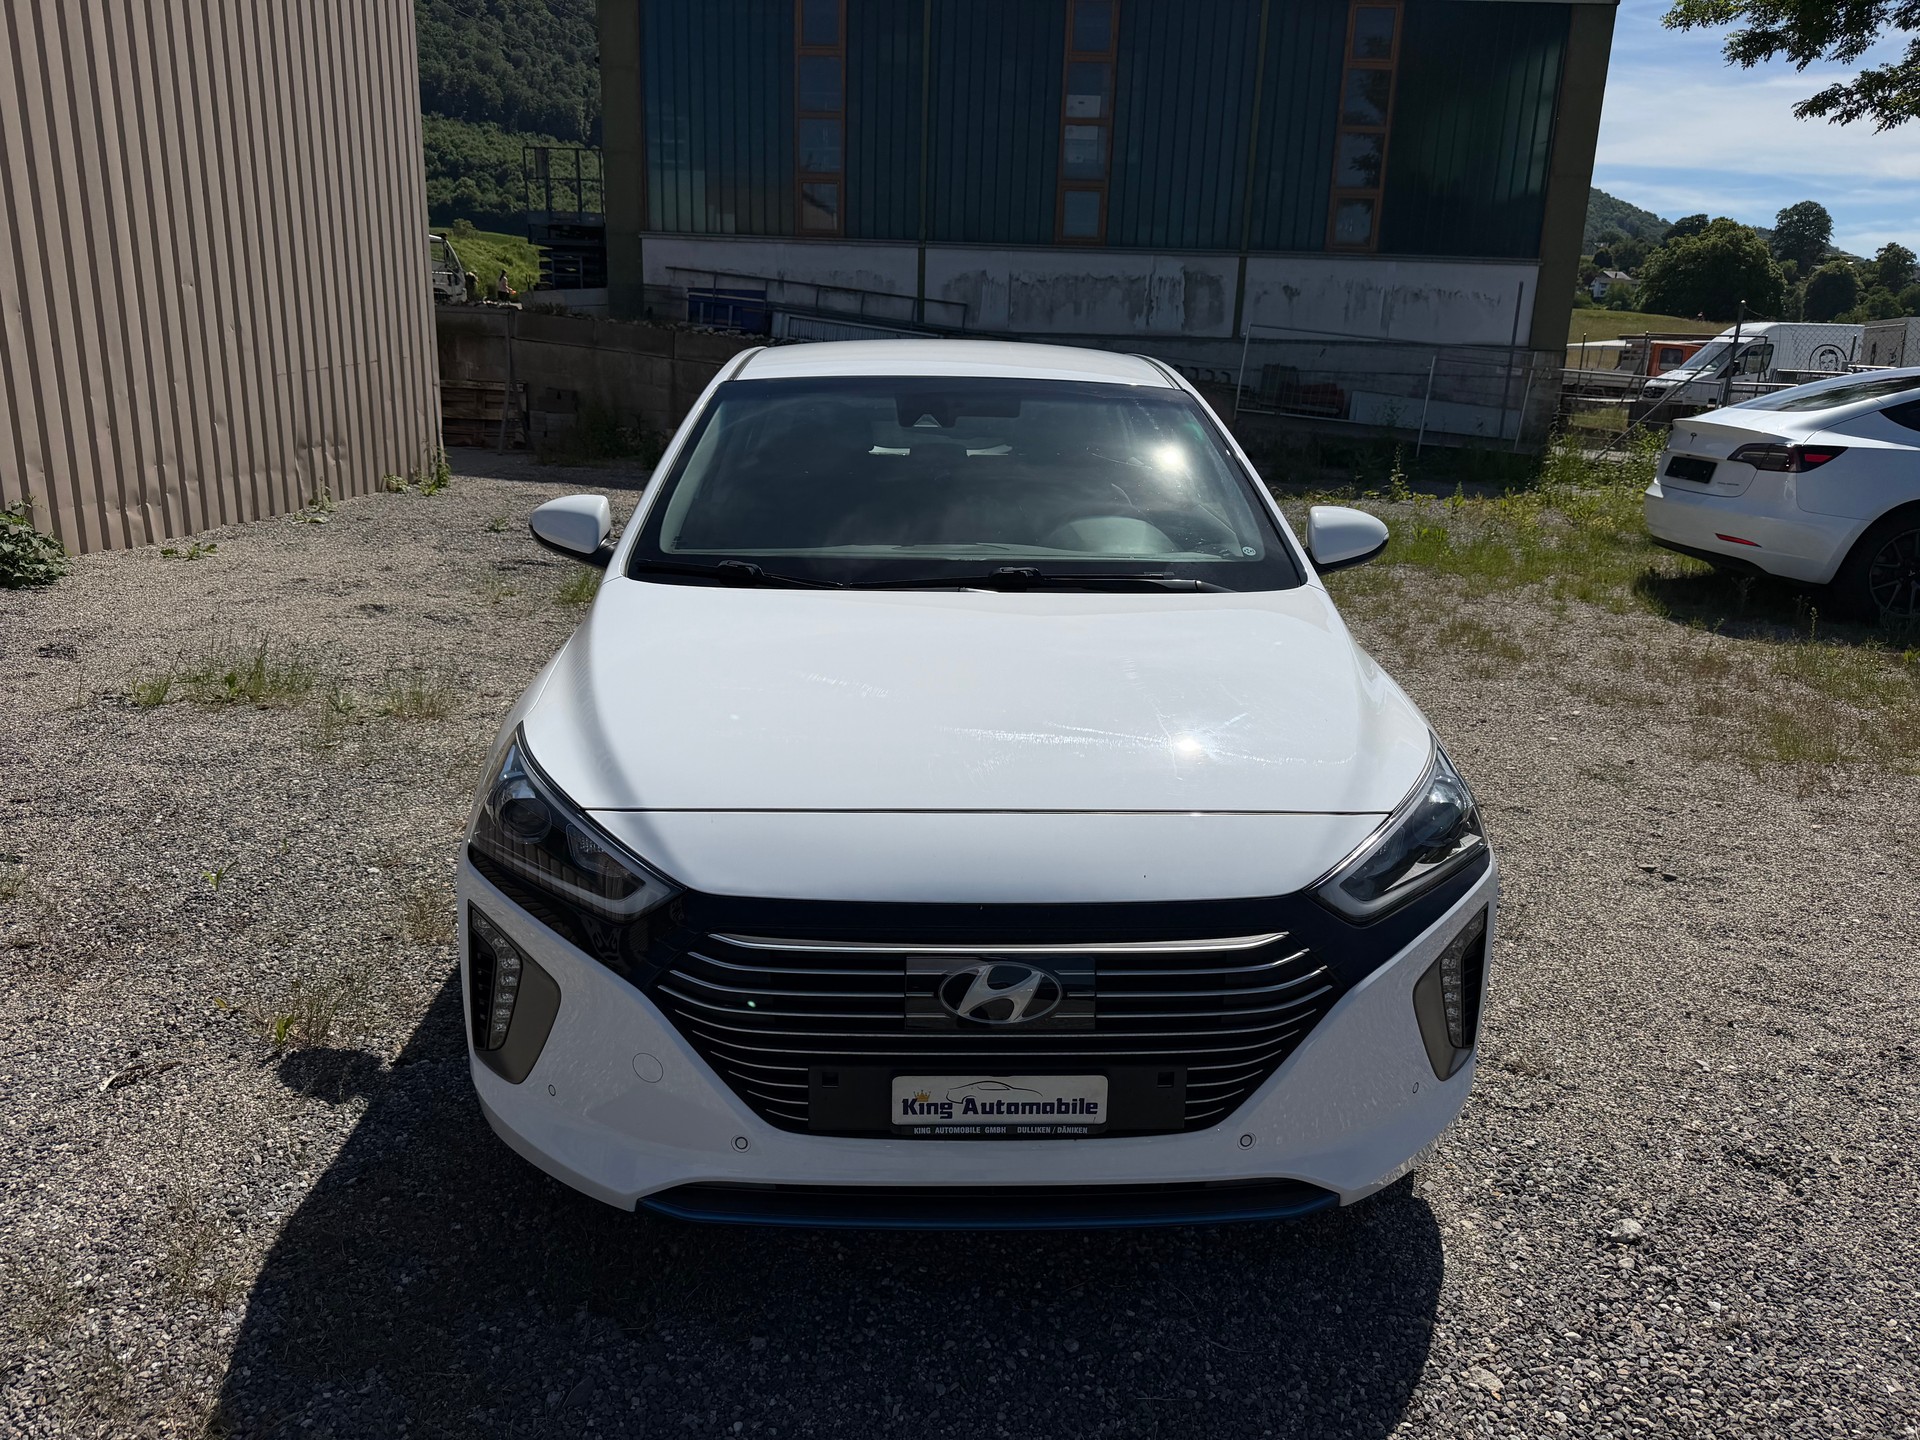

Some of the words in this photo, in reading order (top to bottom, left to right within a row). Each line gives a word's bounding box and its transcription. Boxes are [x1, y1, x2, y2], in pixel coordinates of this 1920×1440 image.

[902, 1098, 953, 1119] King
[962, 1098, 1098, 1115] Automobile
[914, 1126, 931, 1135] KING
[935, 1126, 981, 1134] AUTOMOBILE
[985, 1126, 1007, 1134] GMBH
